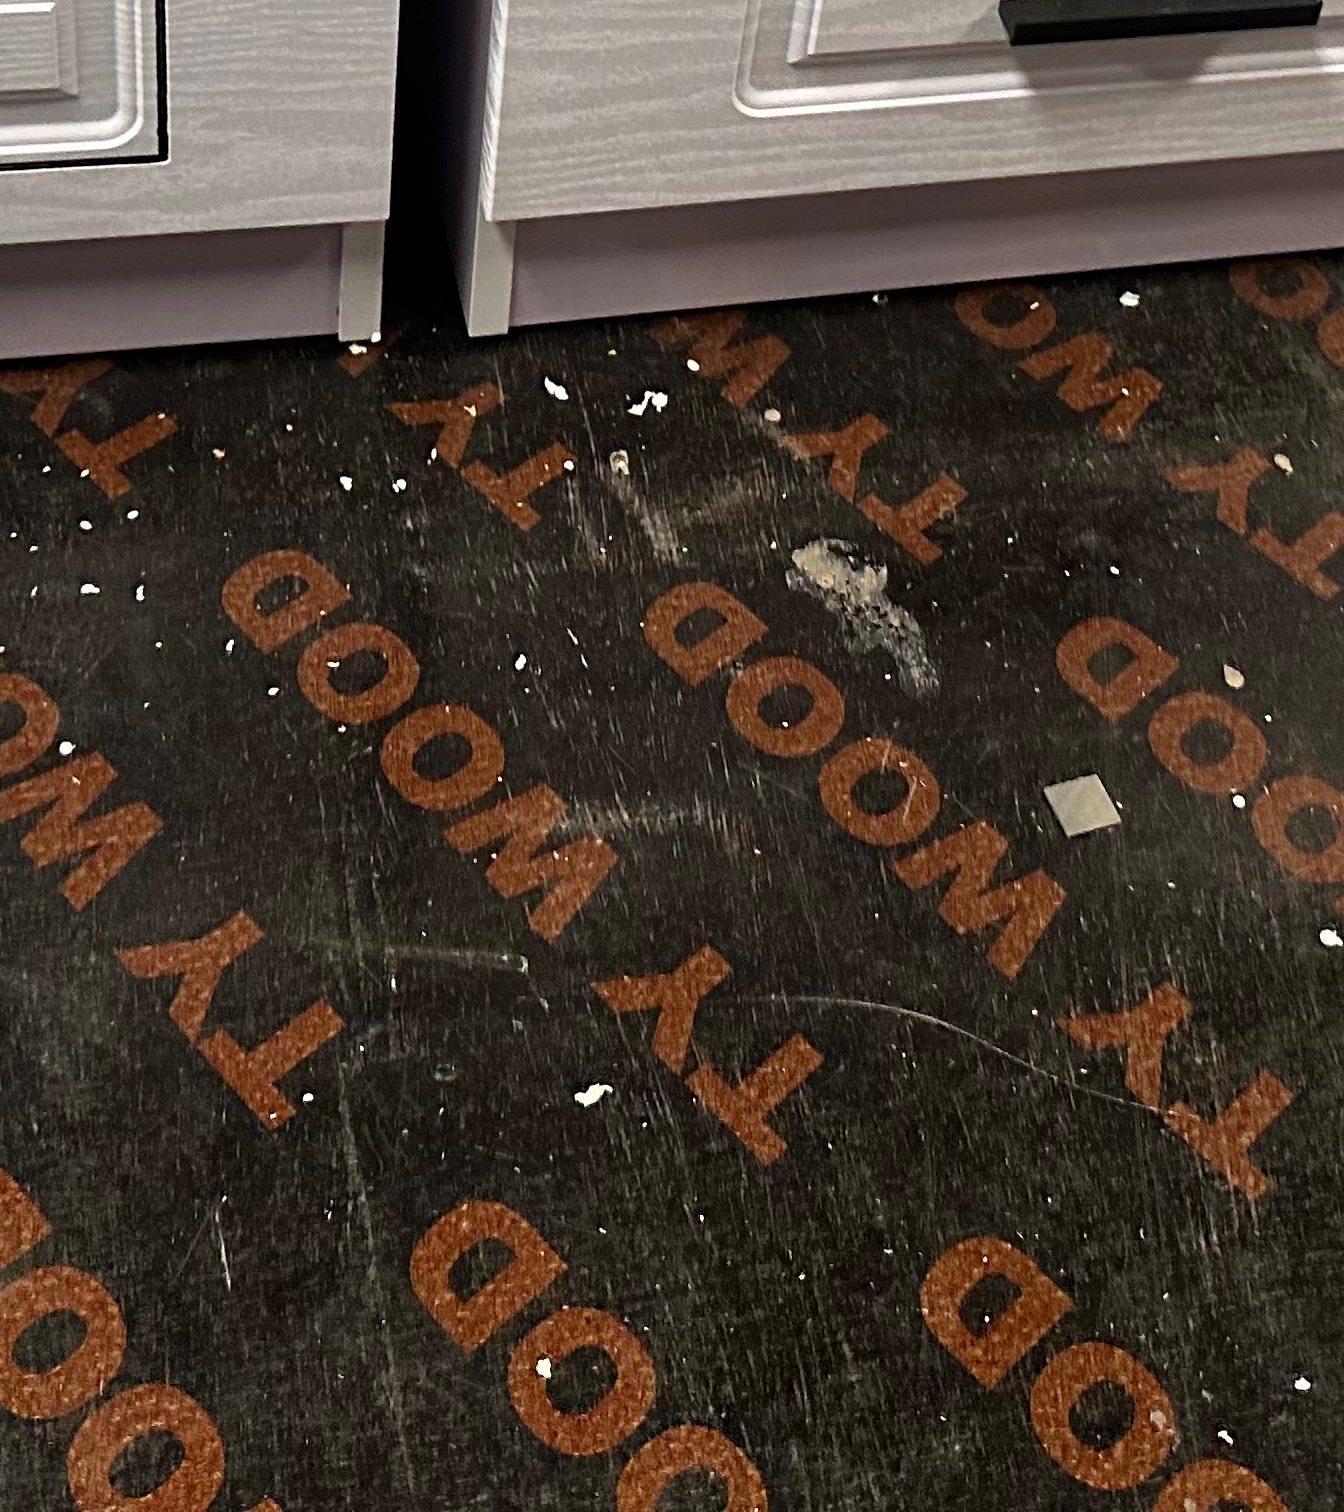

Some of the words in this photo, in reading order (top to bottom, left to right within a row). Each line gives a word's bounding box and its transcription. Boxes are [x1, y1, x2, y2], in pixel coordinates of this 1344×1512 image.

[386, 382, 576, 532] TY
[955, 285, 1163, 443] WO
[781, 413, 967, 564] TY
[222, 549, 618, 942] WOOD
[642, 582, 1067, 980] WOOD
[115, 911, 345, 1131] TY
[591, 945, 824, 1166] TY
[1059, 982, 1293, 1200] TY
